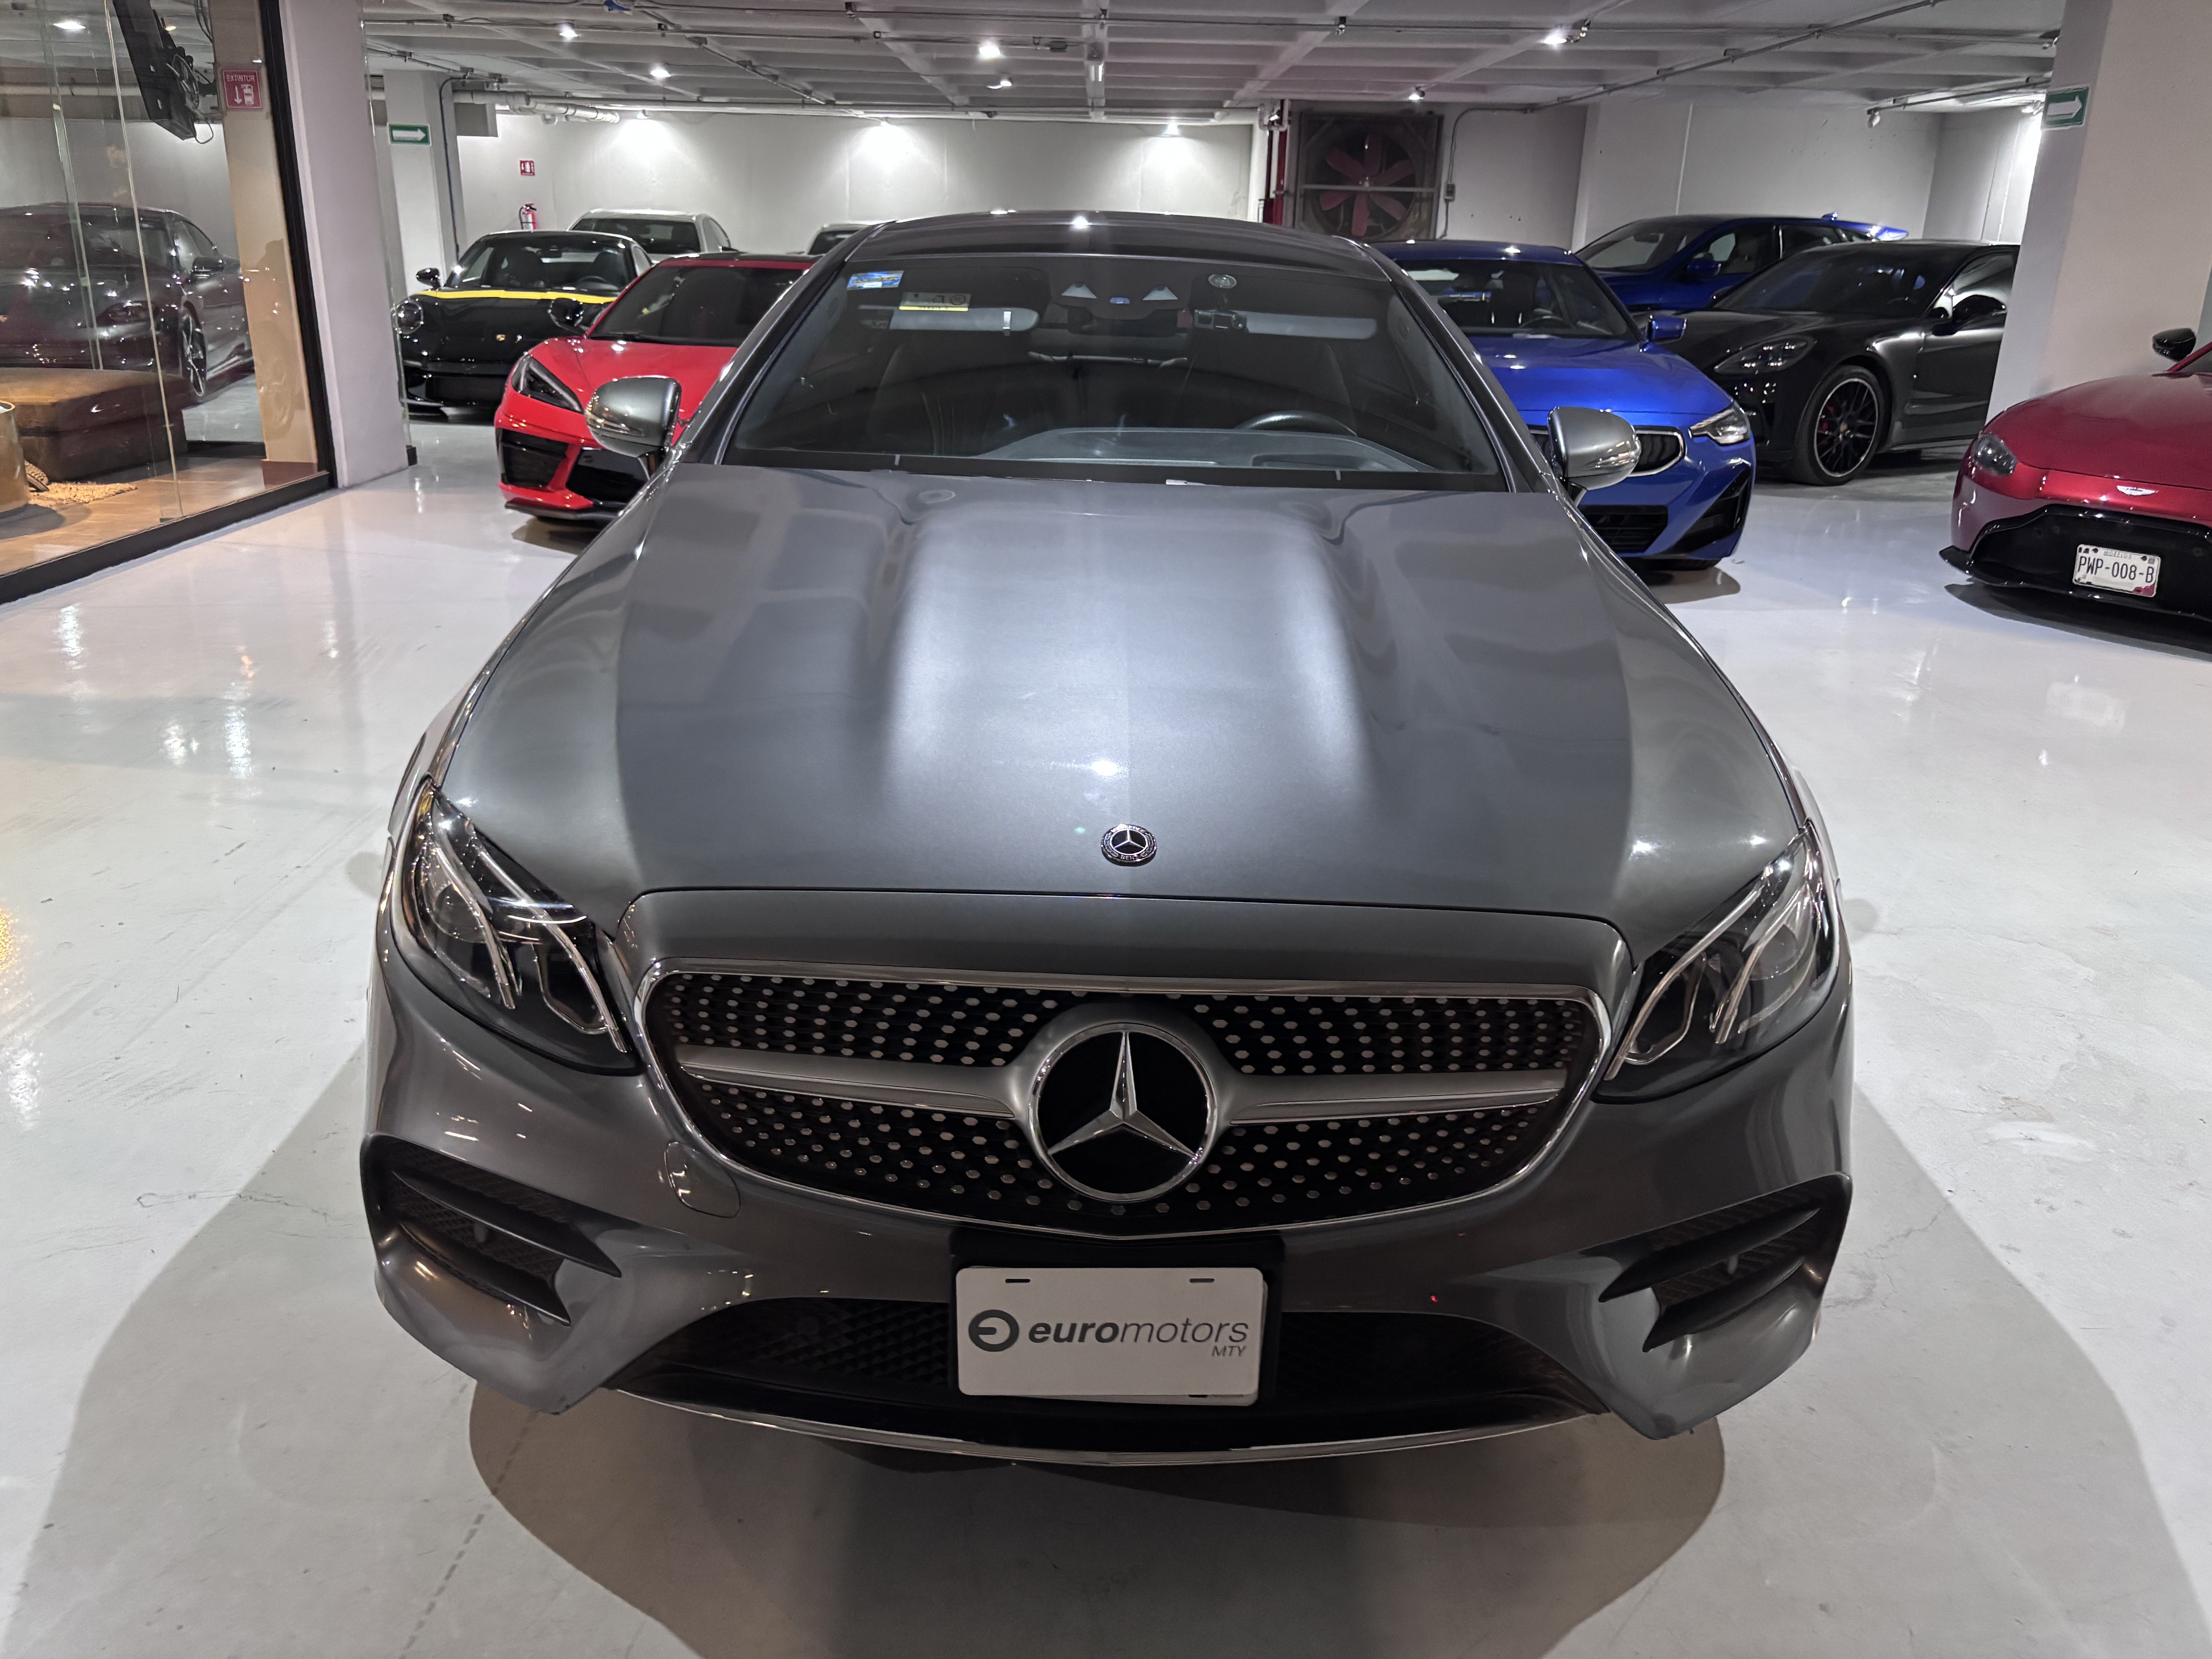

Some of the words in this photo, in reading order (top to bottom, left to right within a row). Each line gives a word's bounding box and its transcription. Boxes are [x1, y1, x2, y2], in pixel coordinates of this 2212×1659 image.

[2077, 556, 2154, 583] PWP-008-B
[1028, 1317, 1249, 1343] euromotors
[1212, 1345, 1247, 1357] MTY
